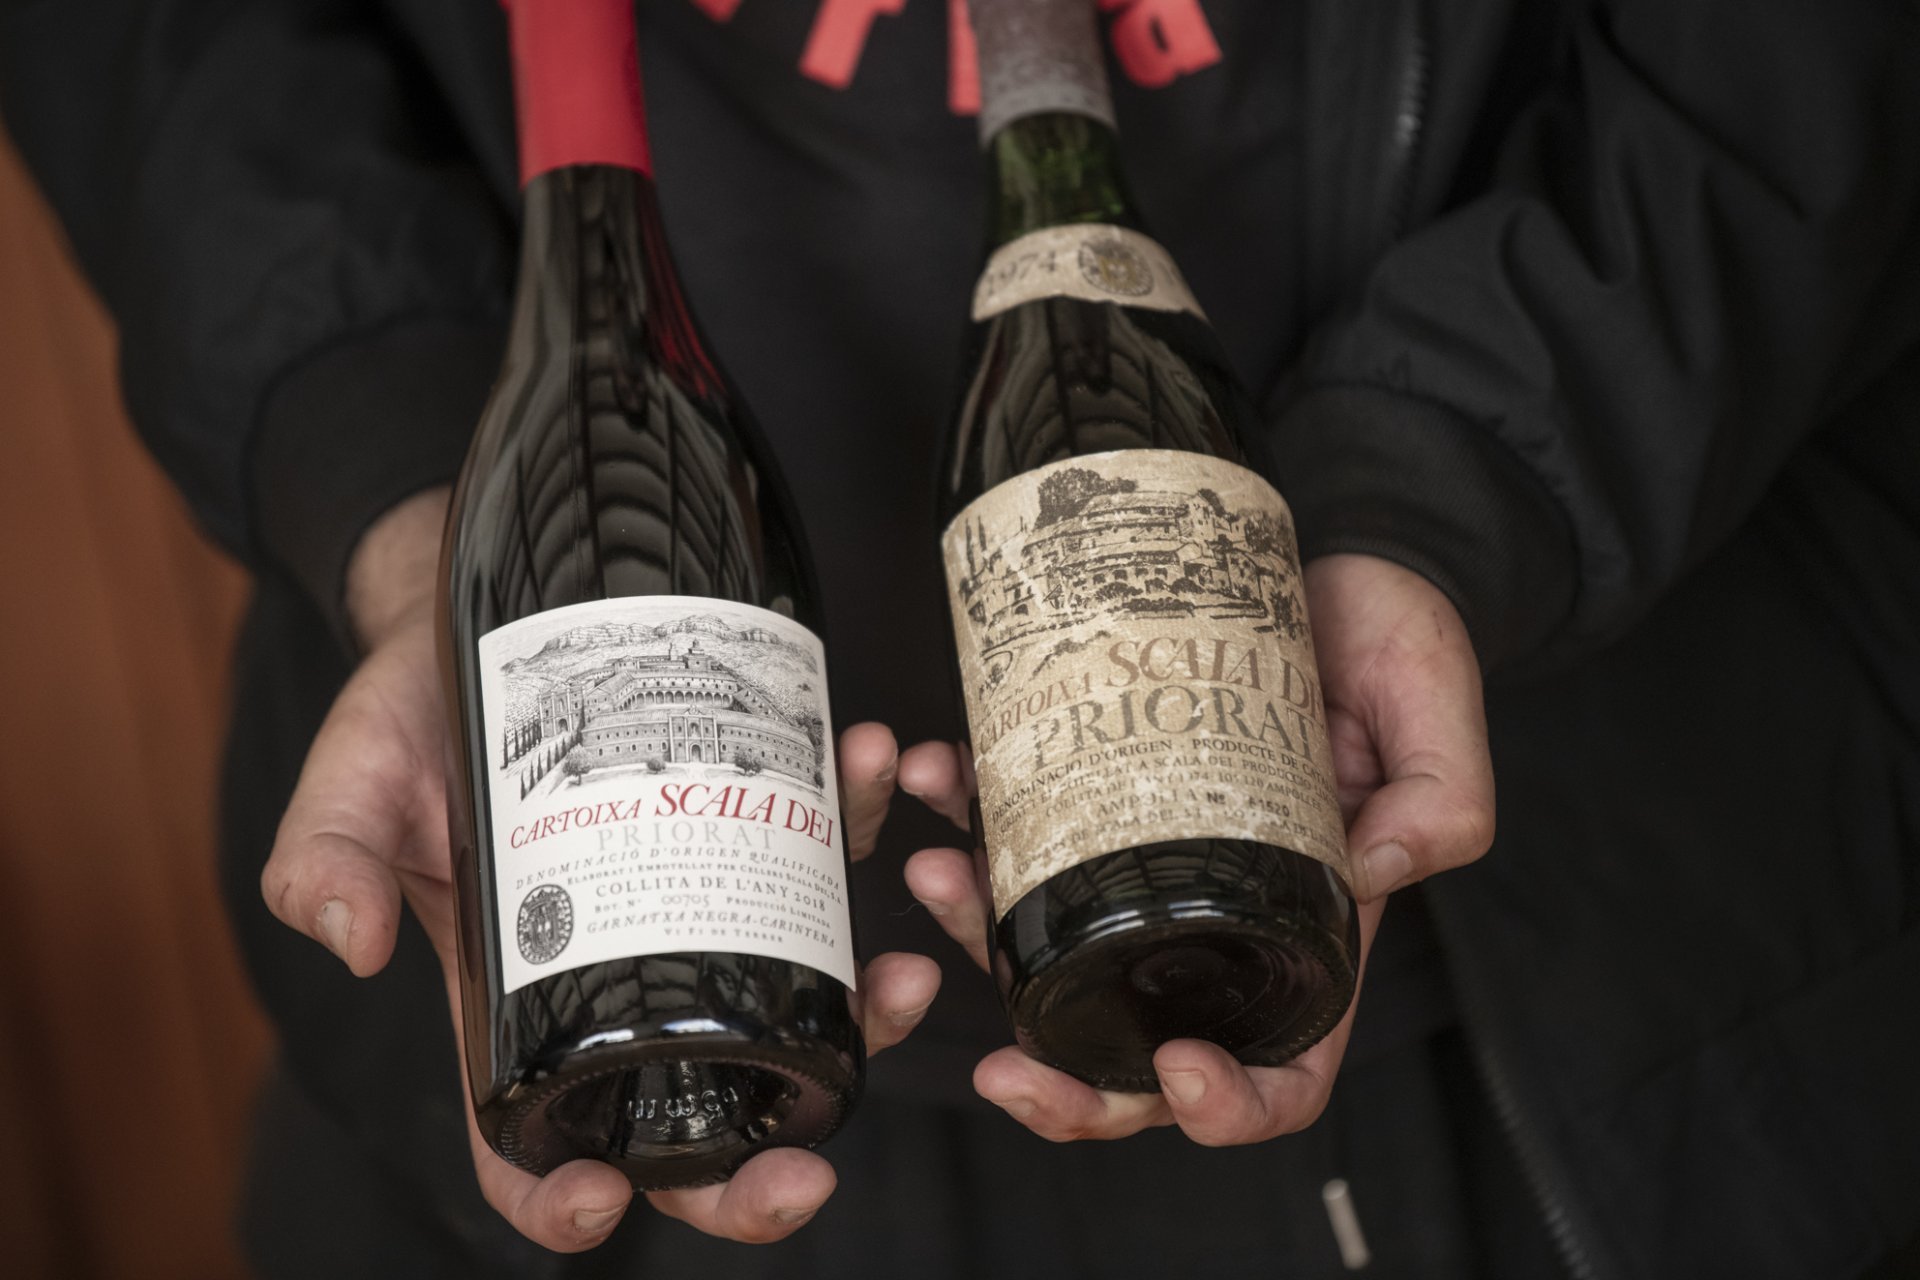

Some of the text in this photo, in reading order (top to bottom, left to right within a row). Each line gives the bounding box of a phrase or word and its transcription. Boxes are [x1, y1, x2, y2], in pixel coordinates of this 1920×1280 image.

[1106, 636, 1268, 692] SCALA
[1030, 684, 1318, 773] PRIORAT
[1154, 755, 1202, 767] SCALA
[1192, 739, 1276, 761] PRODUCTE
[1281, 753, 1299, 770] DE
[511, 783, 834, 849] CARTOIXA SCALA DEI
[597, 819, 777, 851] PRIORAT
[516, 846, 840, 890] DENOMINACIÓ D'ORIGEN QUALIFICADA
[596, 876, 826, 912] COLLITA DE L'ANY 2018
[587, 911, 685, 934] GARNATXA
